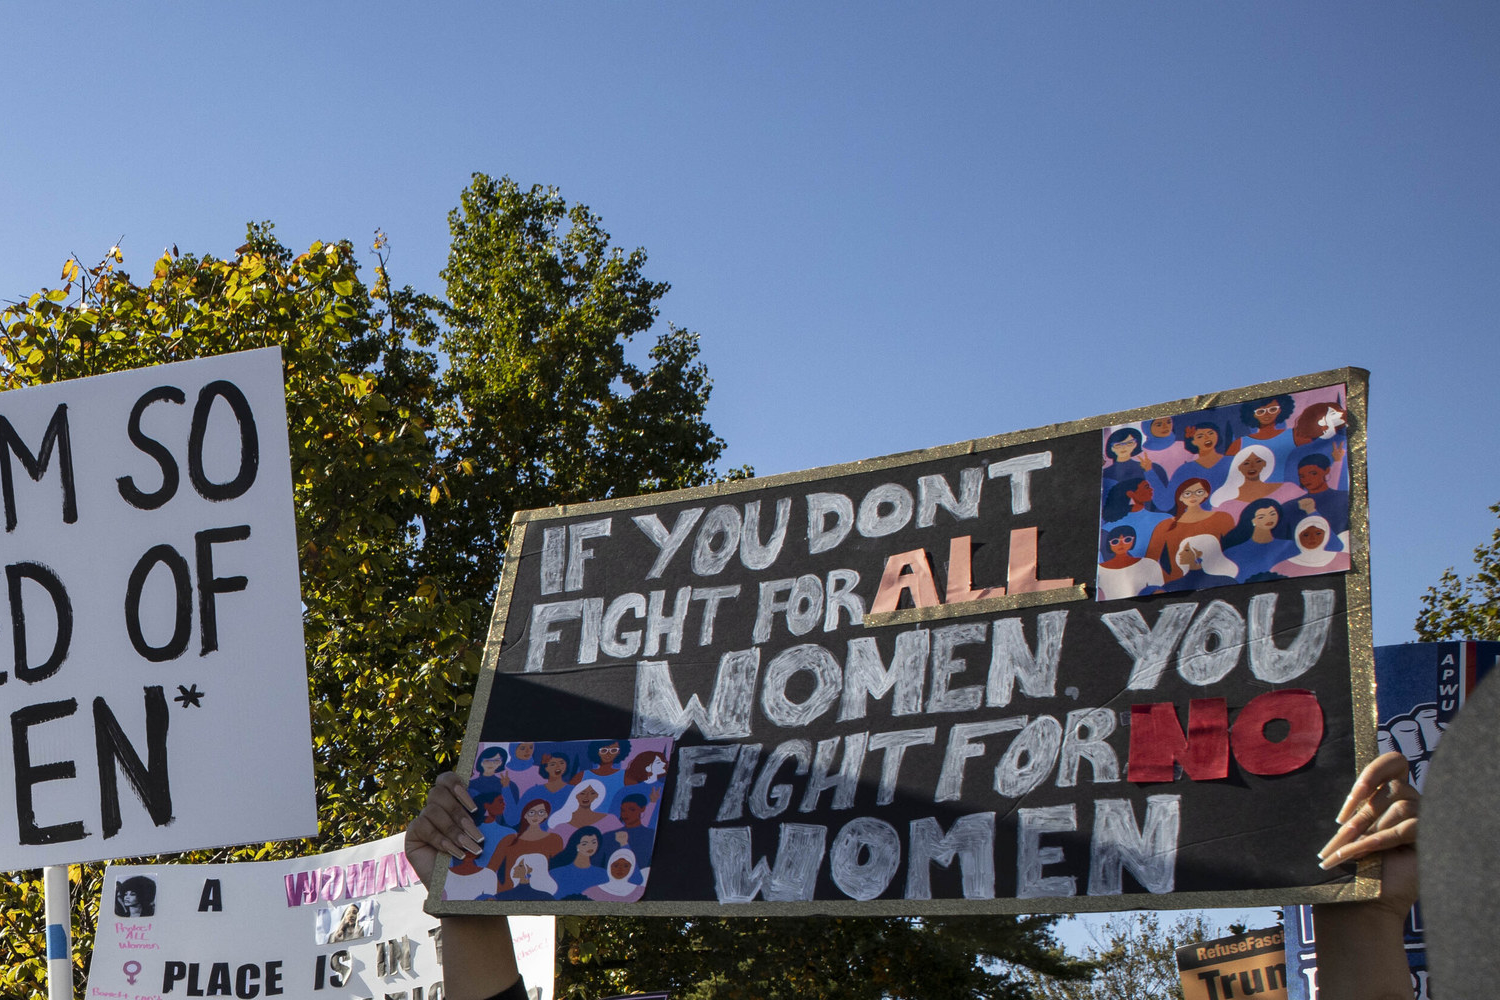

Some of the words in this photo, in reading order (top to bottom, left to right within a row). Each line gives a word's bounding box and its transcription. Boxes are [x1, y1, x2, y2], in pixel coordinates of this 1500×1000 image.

[115, 379, 258, 511] SO
[125, 524, 252, 663] OF
[540, 518, 612, 595] IF
[632, 498, 792, 579] YOU
[524, 584, 741, 673] FIGHT
[751, 567, 868, 645] FOR
[869, 526, 1074, 615] ALL
[1101, 589, 1336, 691] YOU
[669, 727, 937, 822] FIGHT
[935, 707, 1121, 803] FOR
[1127, 688, 1325, 783] NO
[198, 878, 222, 912] A
[709, 794, 1182, 904] WOMEN
[125, 931, 149, 941] ALL
[162, 960, 283, 999] PLACE
[314, 949, 352, 991] IS
[375, 934, 411, 978] IN
[1196, 929, 1285, 961] RefuseFasci
